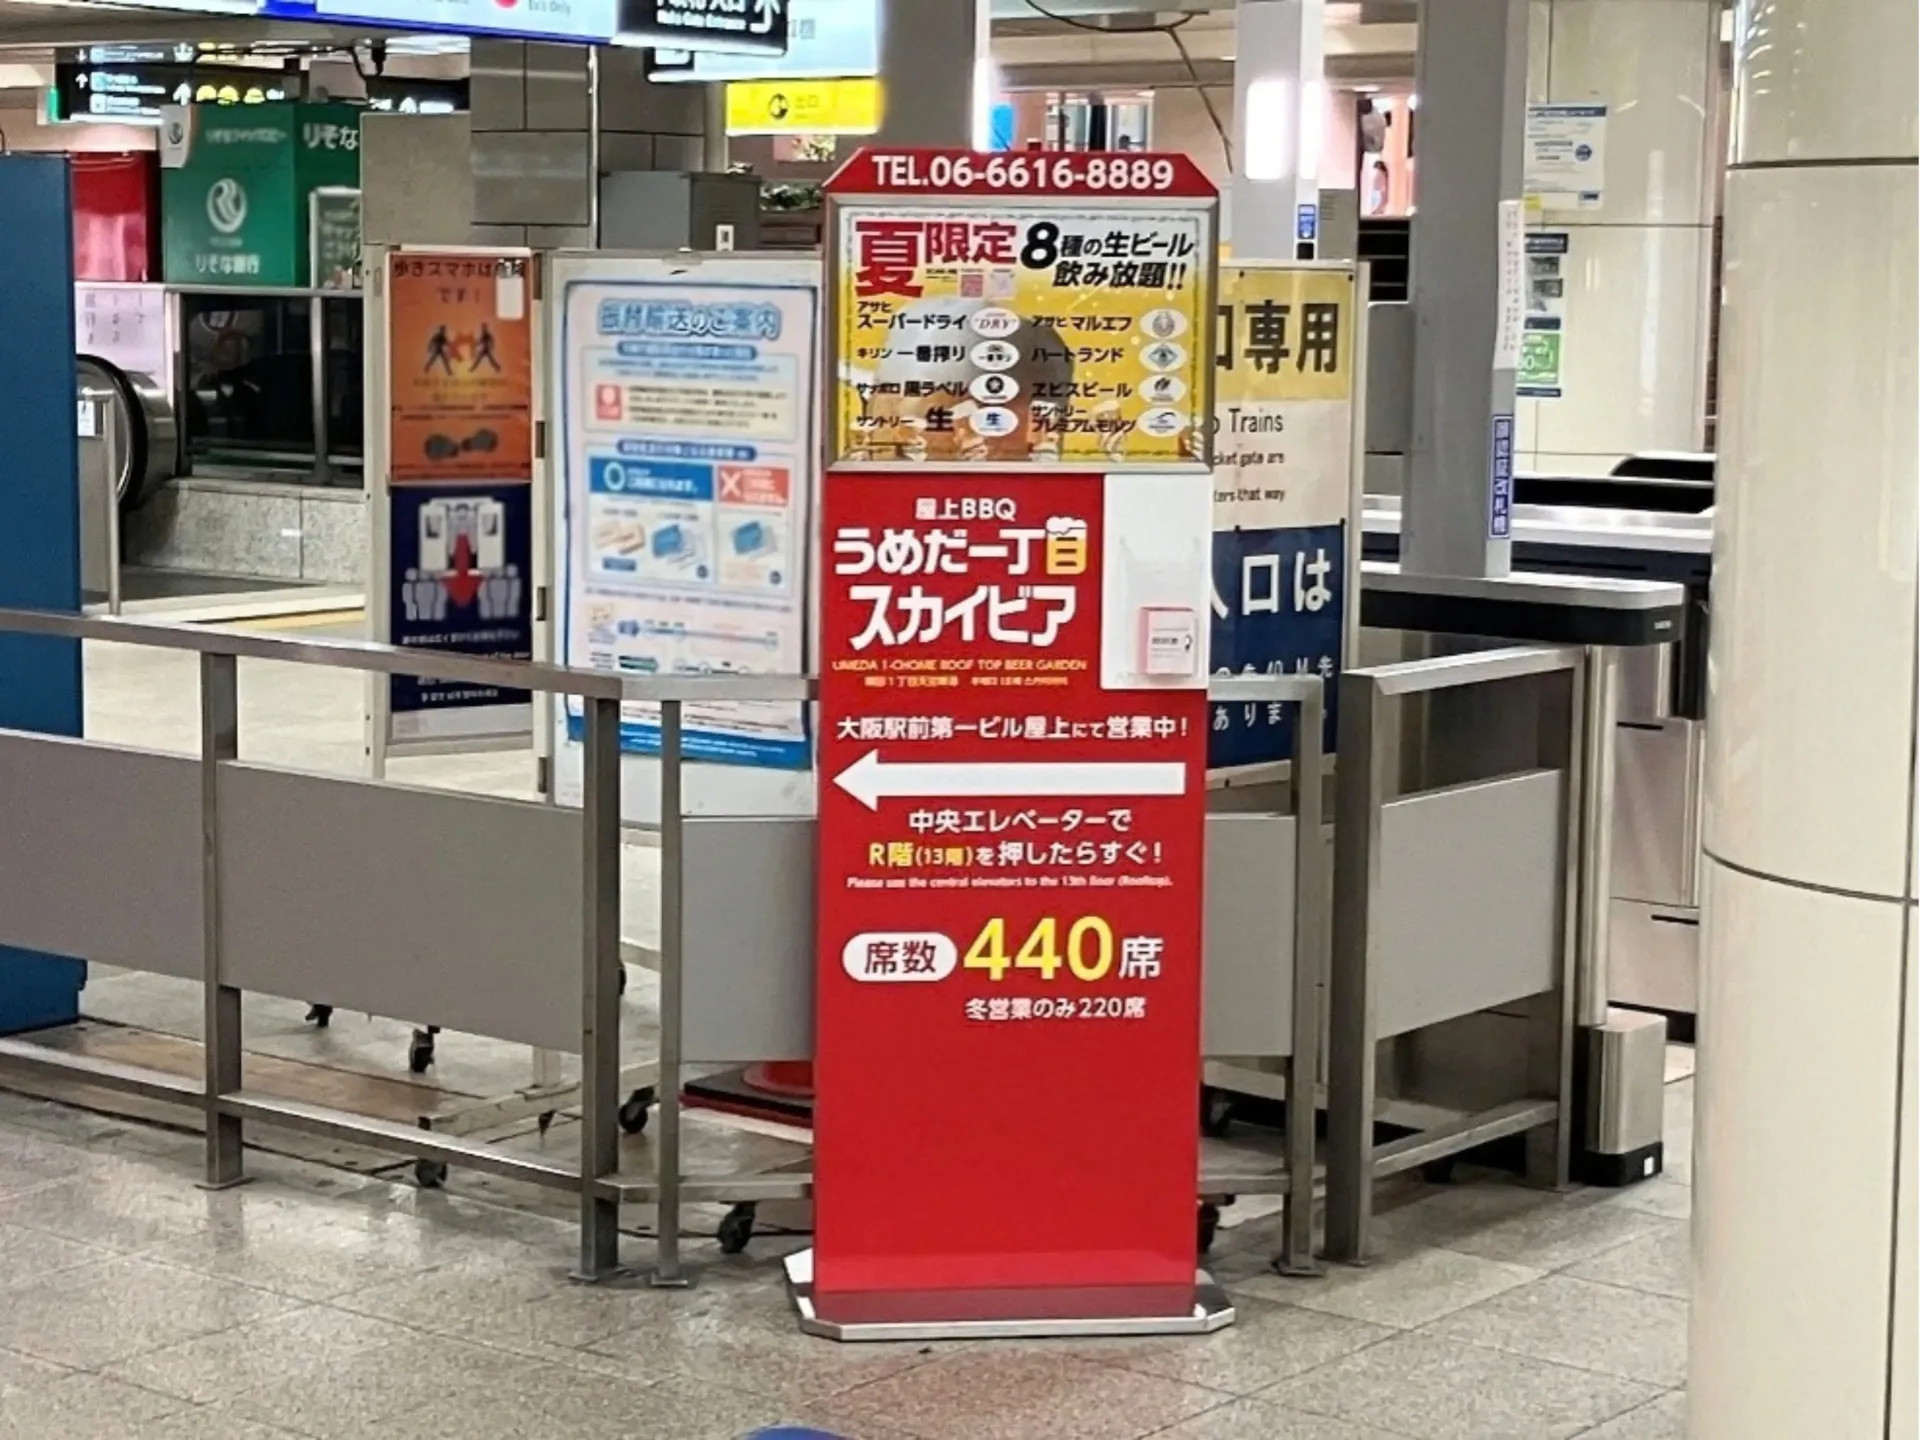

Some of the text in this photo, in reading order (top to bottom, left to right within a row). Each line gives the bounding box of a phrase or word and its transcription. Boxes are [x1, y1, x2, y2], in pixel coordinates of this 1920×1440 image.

[303, 122, 359, 149] りそな
[872, 155, 1174, 190] TEL.06-6616-8889
[1020, 220, 1193, 270] 8種の生ビール
[1053, 259, 1185, 291] 飲み放題!!
[857, 301, 892, 314] アサヒ
[857, 313, 968, 330] スーパードライ
[1032, 315, 1133, 331] アサヒ マルエフ
[857, 345, 966, 363] キリン 一番搾り
[1032, 347, 1125, 363] ハートランド
[856, 380, 969, 398] サッポロ 黒ラベル
[856, 406, 954, 432] サントリー 生
[1031, 404, 1087, 417] サントリー
[1228, 407, 1285, 433] Trains
[1031, 418, 1137, 434] プレミアムモルツ
[1264, 489, 1285, 504] way
[916, 498, 1017, 522] 屋上BBQ
[833, 516, 1088, 576] うめだ一丁目
[848, 584, 1077, 650] スカイビア
[832, 659, 1087, 671] UMEDA 1-CHOME ROOF TOP BEER GARDEN
[837, 716, 1190, 741] 大阪駅前第一ビル屋上にて営業中！
[1213, 703, 1284, 730] ありま
[909, 808, 1133, 834] 中央エレベーターで
[868, 841, 1162, 868] R階(13階)を押したらすぐ！
[847, 876, 883, 888] Please
[1024, 876, 1037, 887] to
[864, 939, 937, 976] 席数
[965, 997, 1148, 1020] 冬営業のみ220席
